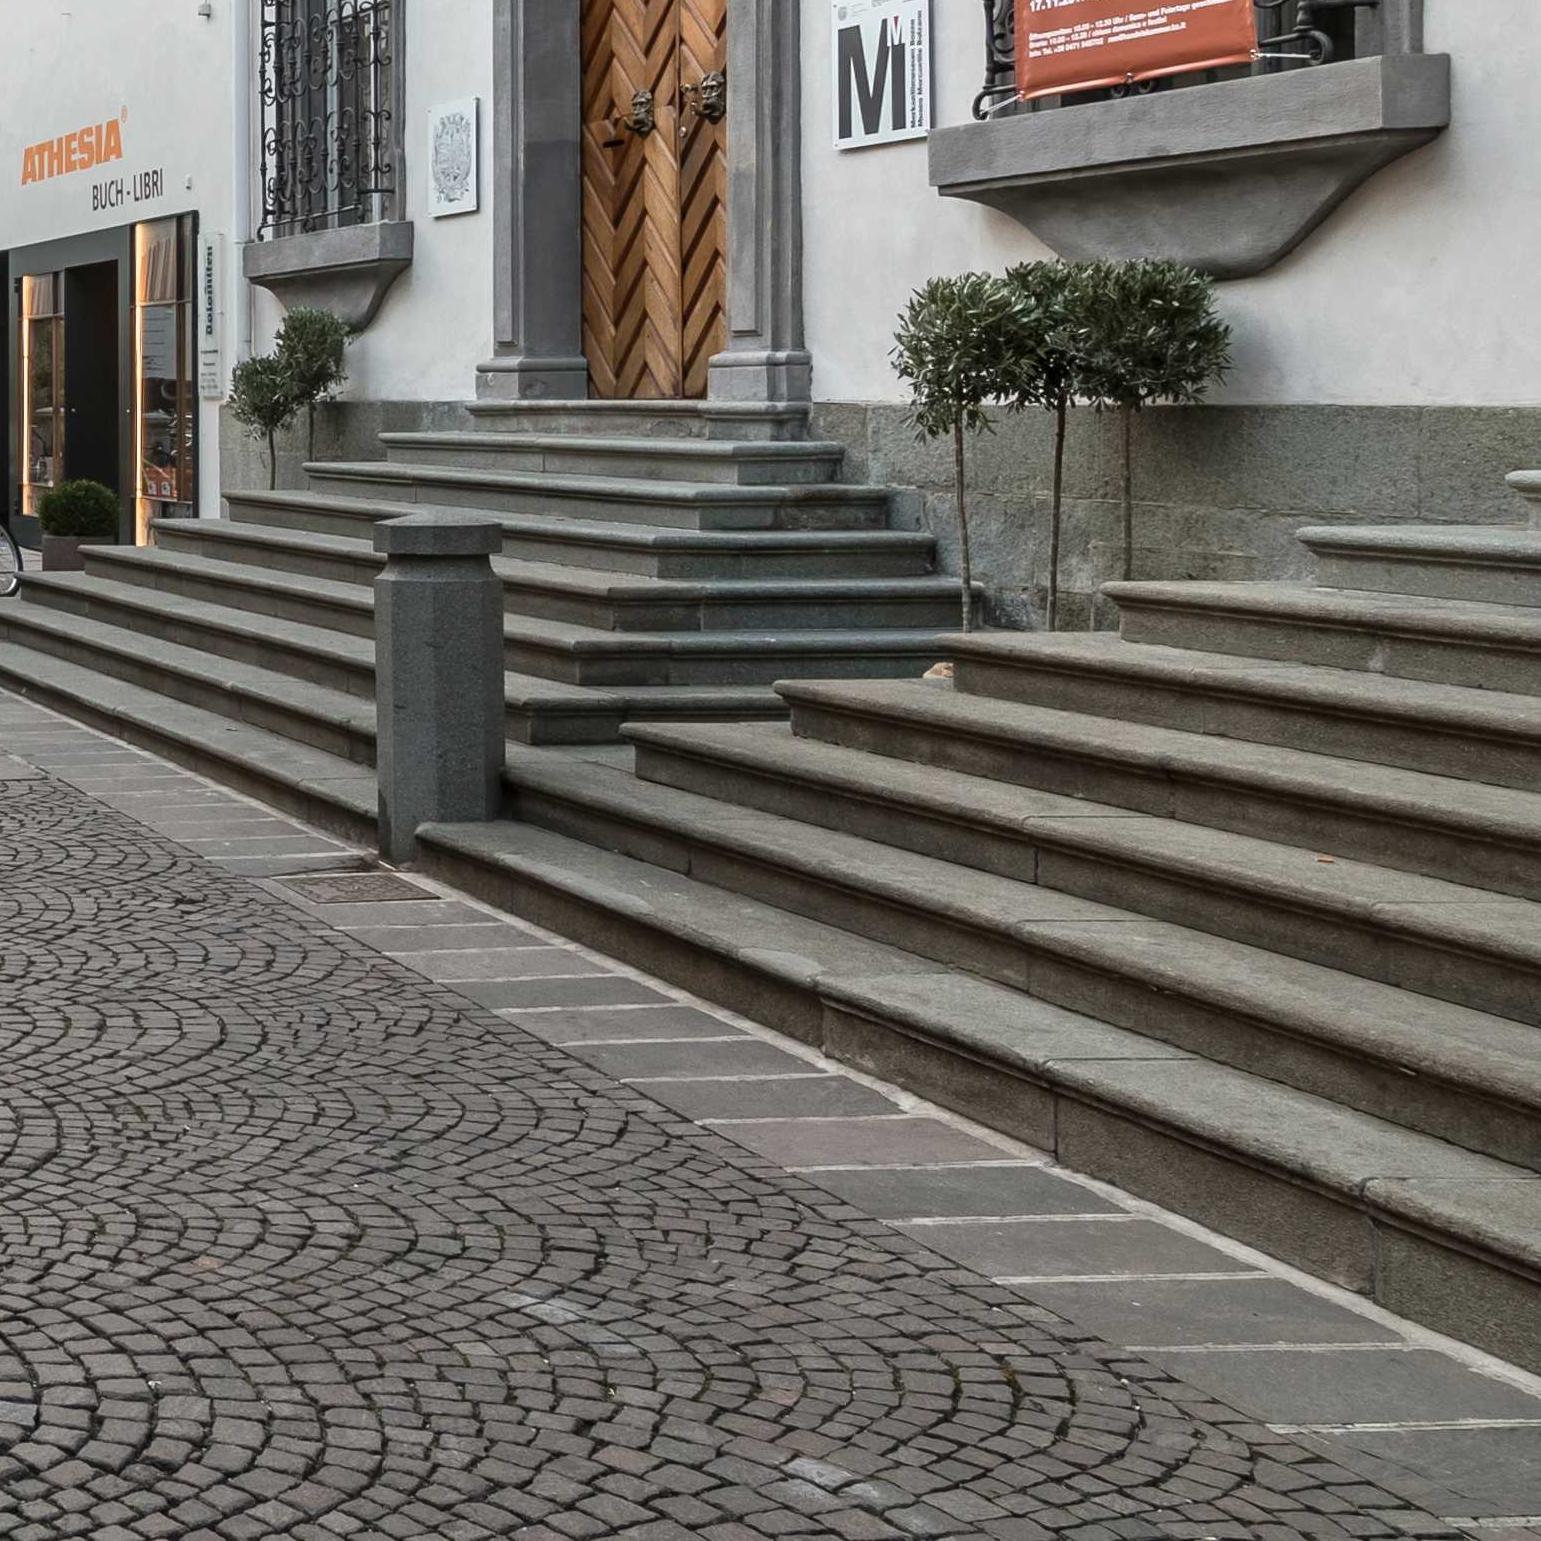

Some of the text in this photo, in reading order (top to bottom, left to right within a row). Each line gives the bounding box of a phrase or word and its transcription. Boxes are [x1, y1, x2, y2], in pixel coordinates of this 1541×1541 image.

[22, 118, 123, 186] ATHESIA
[92, 179, 124, 211] BUCH
[133, 168, 163, 202] LIBRI
